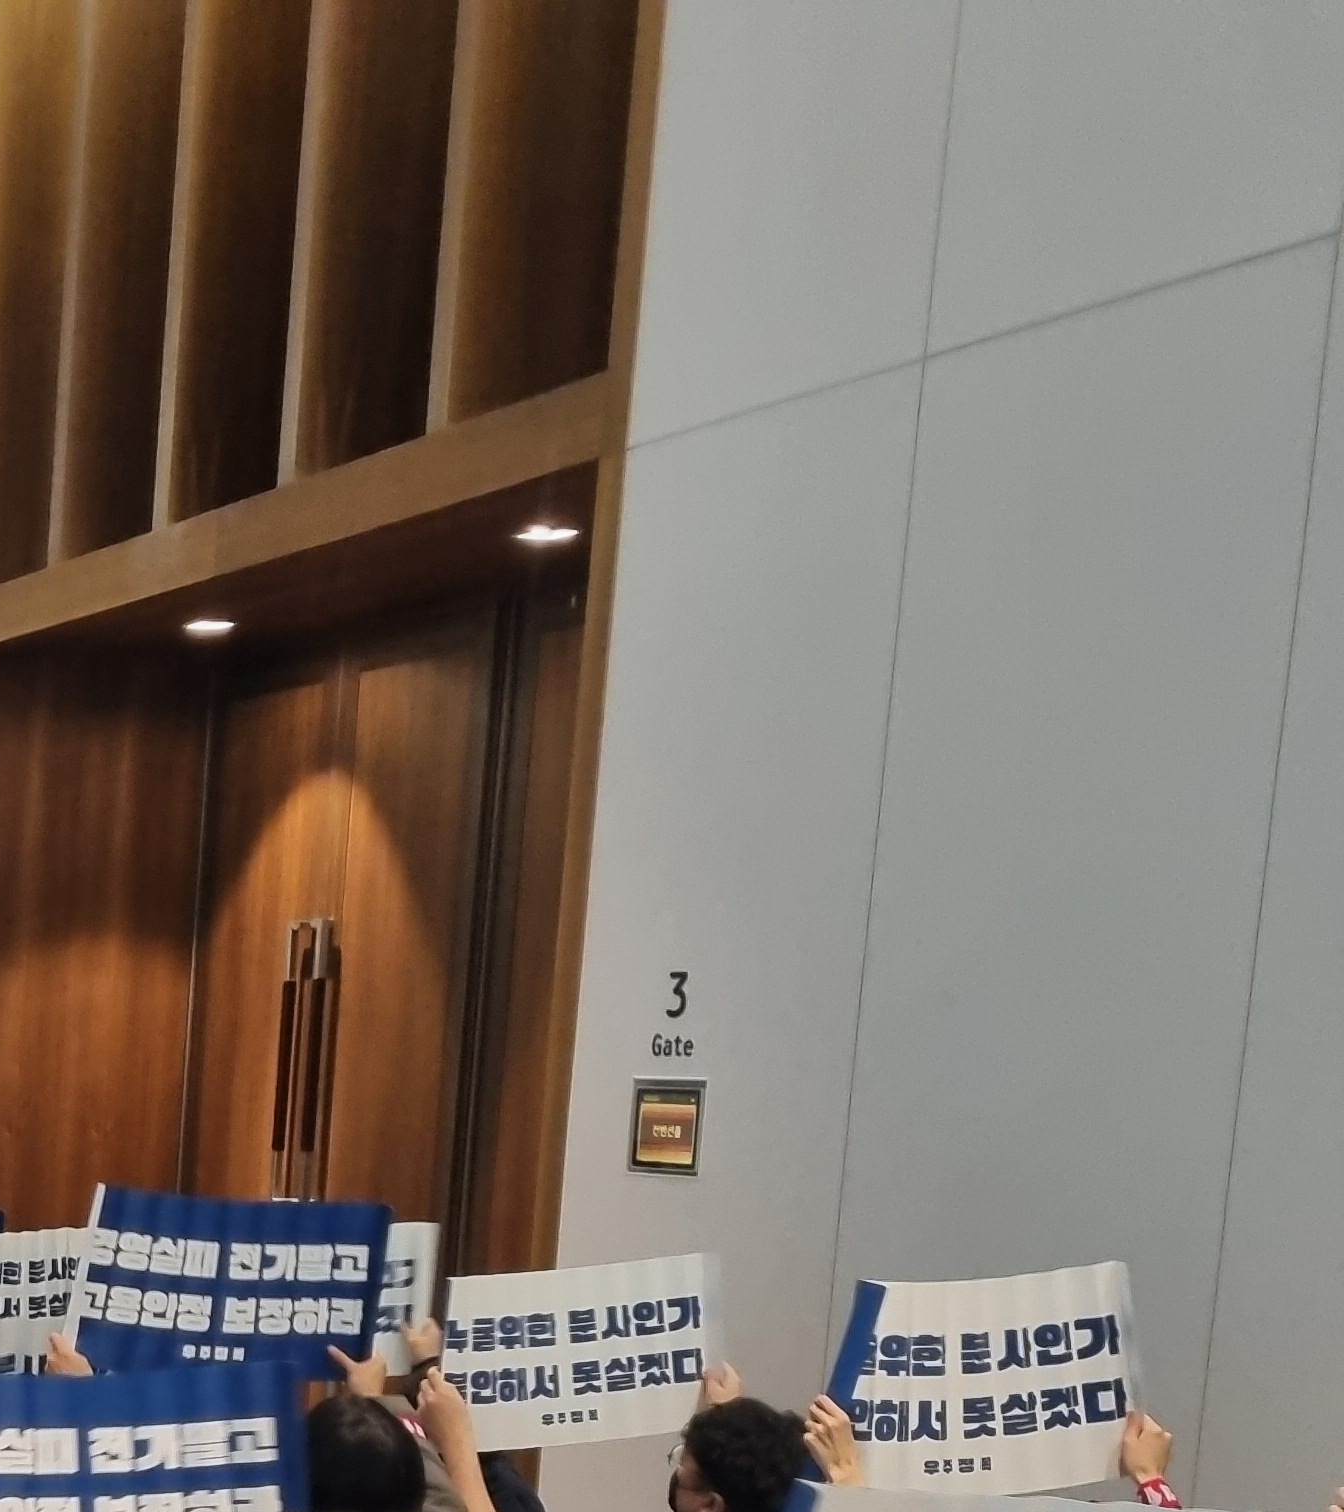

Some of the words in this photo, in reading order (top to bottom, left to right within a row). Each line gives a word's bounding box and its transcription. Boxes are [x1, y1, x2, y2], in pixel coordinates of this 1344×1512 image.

[666, 971, 689, 1018] 3
[651, 1033, 695, 1057] Gate
[228, 1242, 369, 1282] 전가말고
[82, 1281, 213, 1332] 고용안정
[222, 1296, 364, 1336] 보장하라
[568, 1296, 701, 1343] 분사인가
[862, 1333, 946, 1376] 위한
[960, 1314, 1120, 1376] 분사인가
[572, 1348, 703, 1396] 못살겠다
[851, 1398, 948, 1442] 안해서
[963, 1377, 1127, 1440] 못살겠다
[88, 1417, 280, 1475] 전가말고
